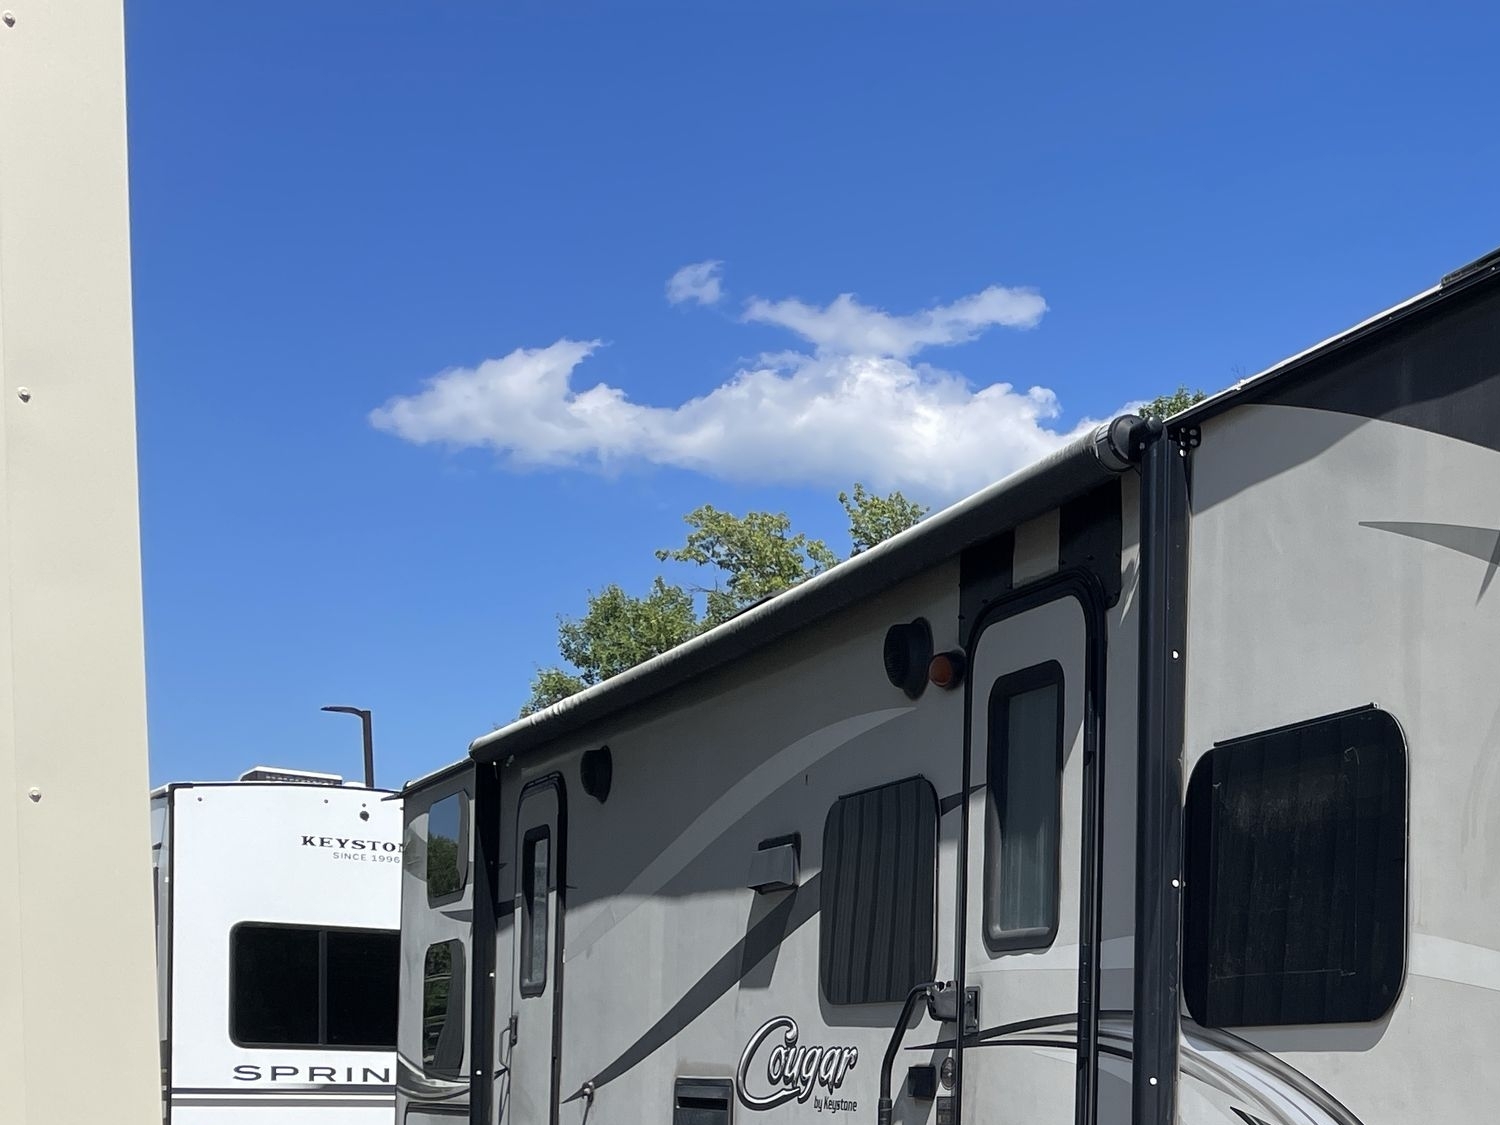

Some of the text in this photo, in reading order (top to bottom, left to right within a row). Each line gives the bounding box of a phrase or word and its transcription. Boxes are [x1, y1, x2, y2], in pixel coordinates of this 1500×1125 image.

[332, 851, 401, 864] SINCE 1996
[736, 1015, 858, 1111] Cougar
[232, 1064, 390, 1083] SPRIN
[814, 1095, 858, 1114] by Keystone
